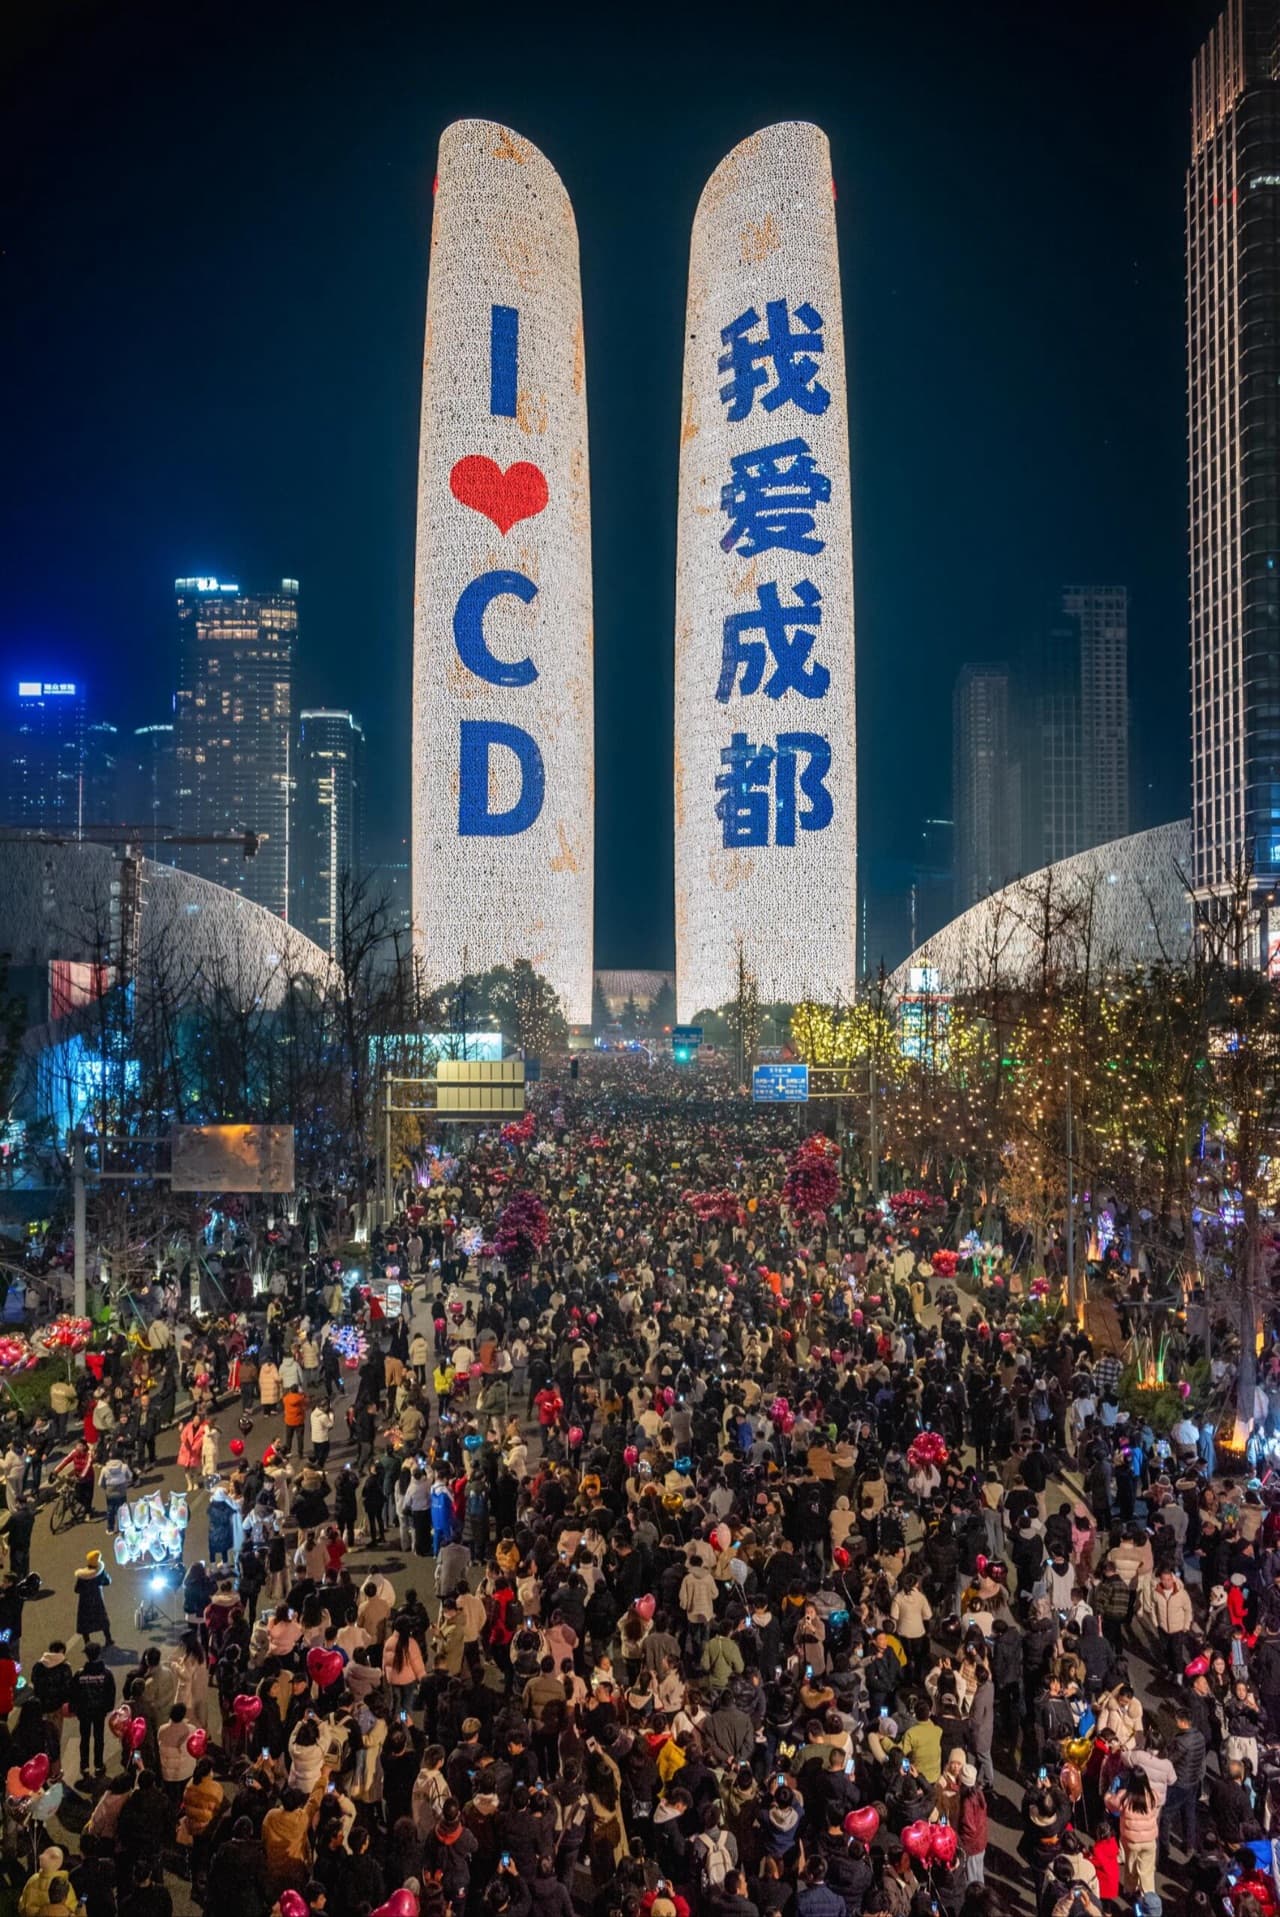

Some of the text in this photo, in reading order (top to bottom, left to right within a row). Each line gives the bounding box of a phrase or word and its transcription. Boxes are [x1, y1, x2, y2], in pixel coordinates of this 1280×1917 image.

[490, 304, 518, 418] I
[714, 298, 834, 848] 我爱成都
